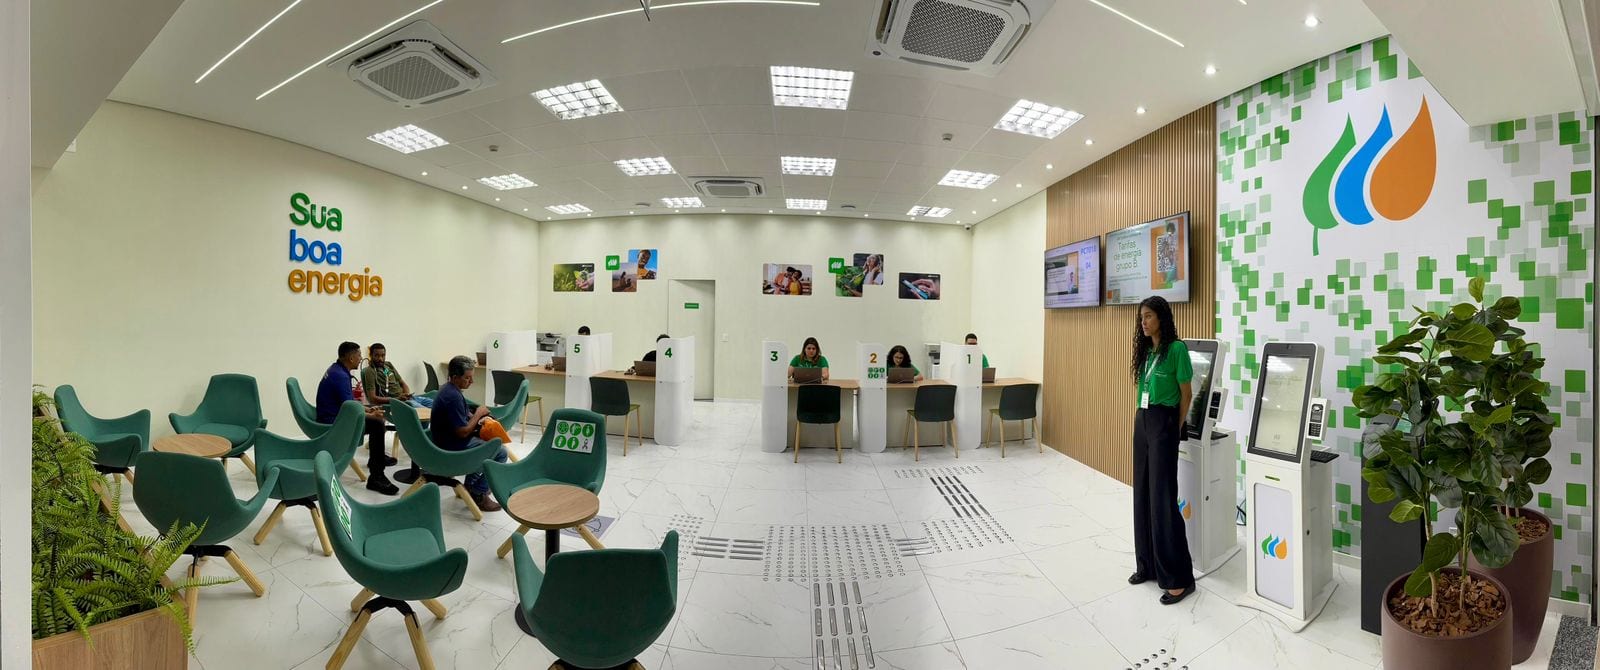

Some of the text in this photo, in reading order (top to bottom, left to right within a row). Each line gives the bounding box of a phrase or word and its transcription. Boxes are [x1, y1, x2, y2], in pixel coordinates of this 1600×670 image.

[289, 192, 343, 232] Sua
[289, 229, 343, 266] boa
[1118, 240, 1137, 250] Tarifas
[1113, 247, 1142, 261] de energia
[1115, 261, 1133, 272] grupo
[288, 267, 383, 302] energia
[493, 339, 499, 349] 6
[574, 344, 580, 353] 5
[665, 347, 673, 358] 4
[770, 351, 778, 361] 3
[869, 353, 877, 363] 2
[967, 354, 971, 364] 1
